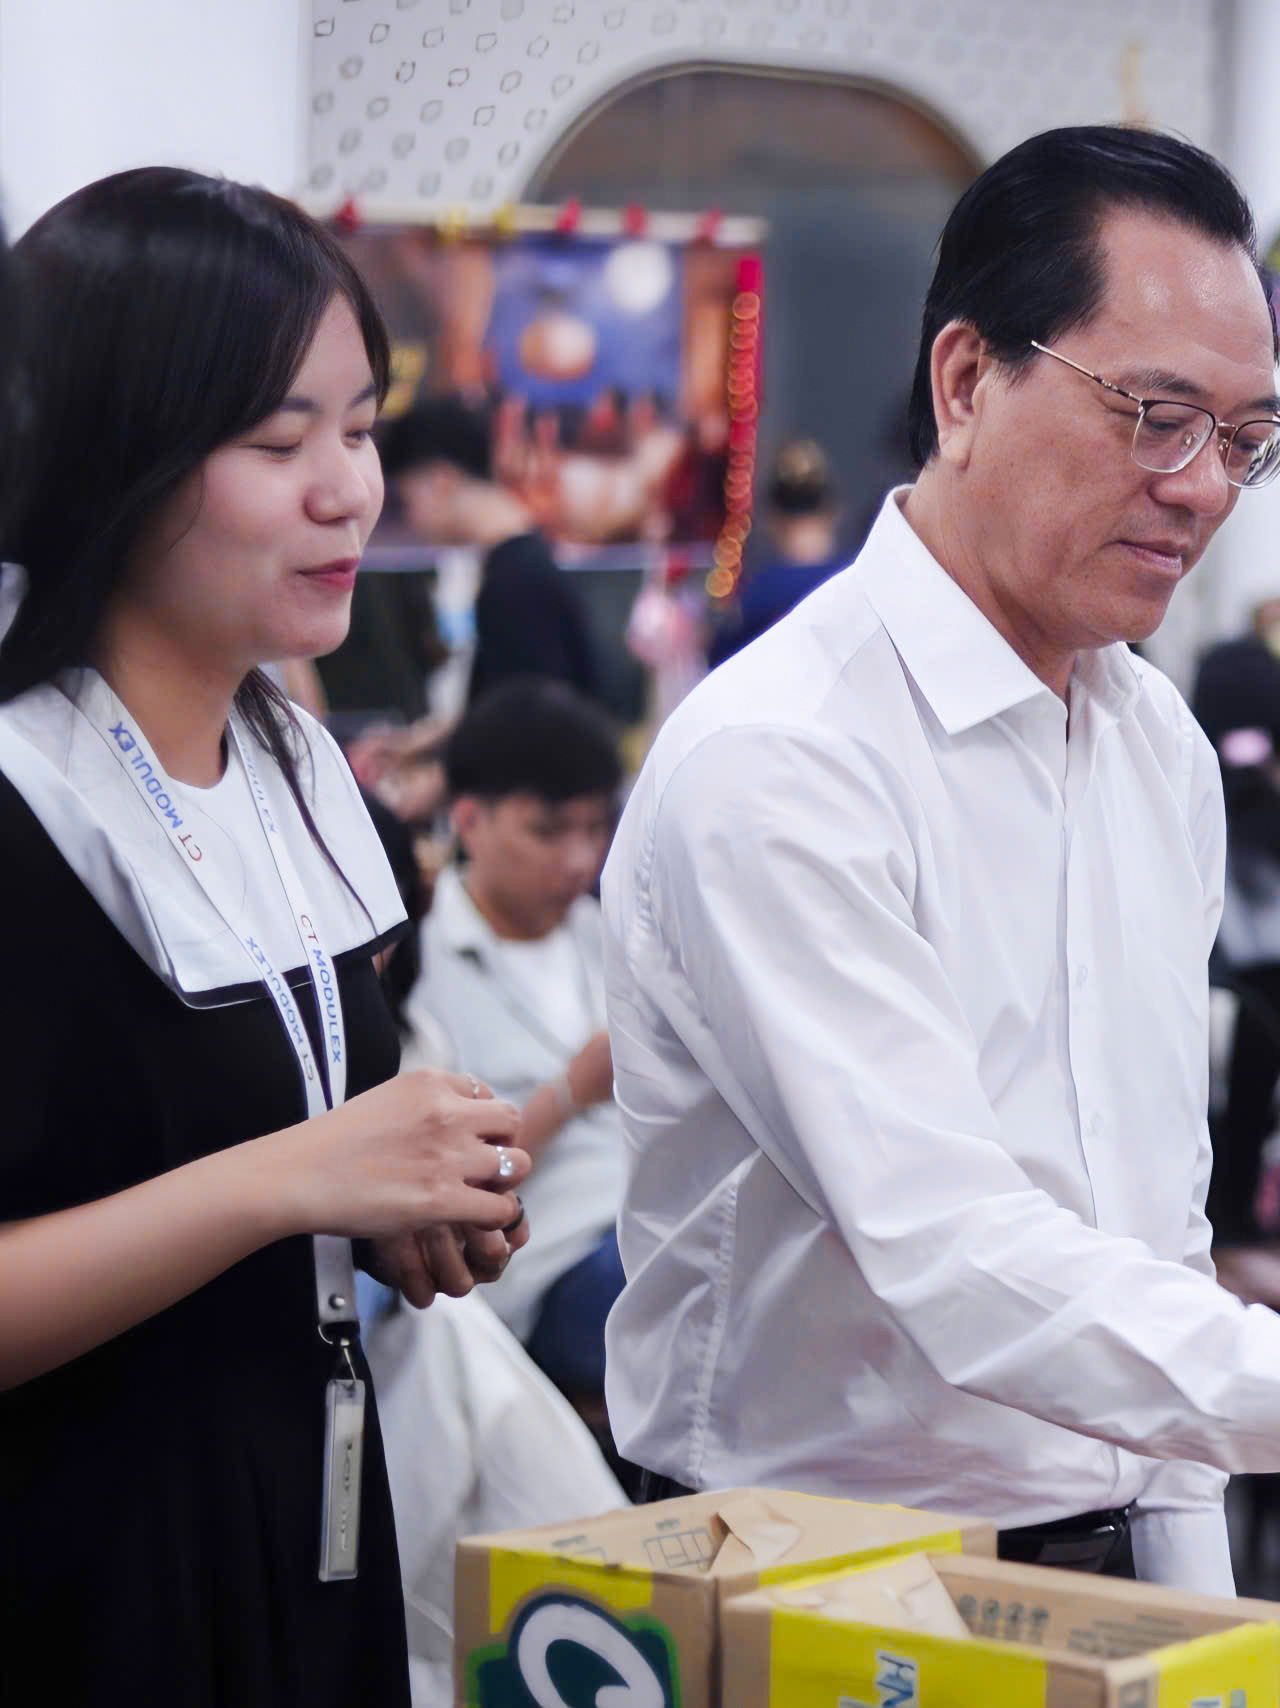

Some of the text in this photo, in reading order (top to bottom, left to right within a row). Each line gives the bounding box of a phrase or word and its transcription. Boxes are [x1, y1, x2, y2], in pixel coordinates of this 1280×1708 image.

[108, 721, 202, 861] CT MODULEX
[301, 914, 341, 1063] CT MODULEX
